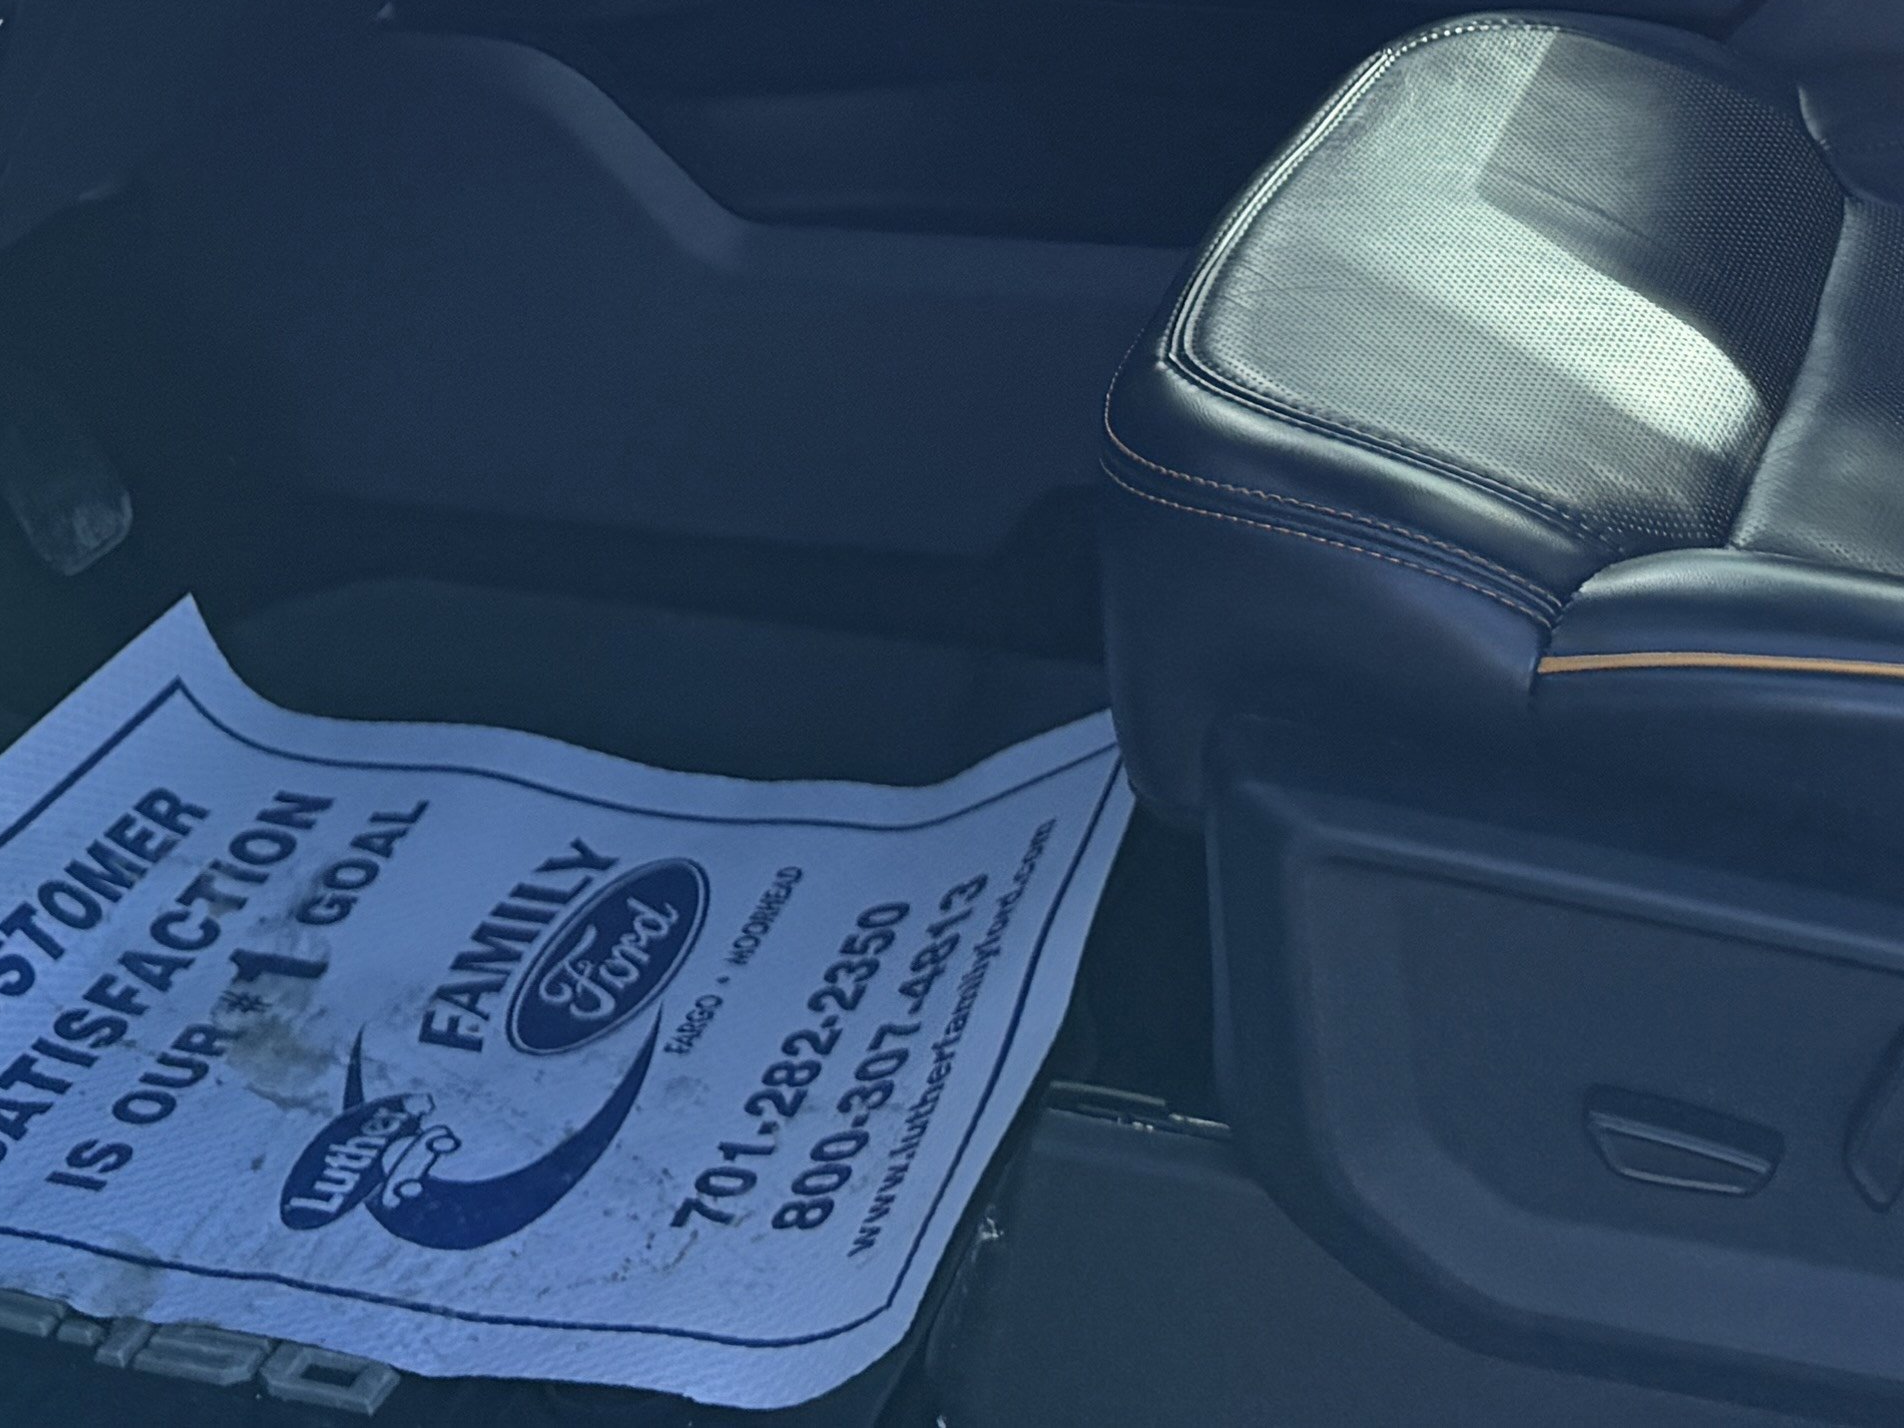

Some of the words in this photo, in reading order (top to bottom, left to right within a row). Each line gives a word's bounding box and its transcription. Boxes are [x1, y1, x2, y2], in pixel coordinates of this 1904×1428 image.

[45, 1138, 134, 1193] IS
[111, 1022, 244, 1126] OUR
[295, 799, 431, 927] GOAL
[418, 836, 621, 1054] FAMILY
[538, 896, 681, 1022] Ford
[662, 994, 724, 1055] FARGO
[723, 865, 804, 966] MOORHEAD
[668, 900, 912, 1229] 701-282-2350
[771, 872, 989, 1232] 800-307-4813
